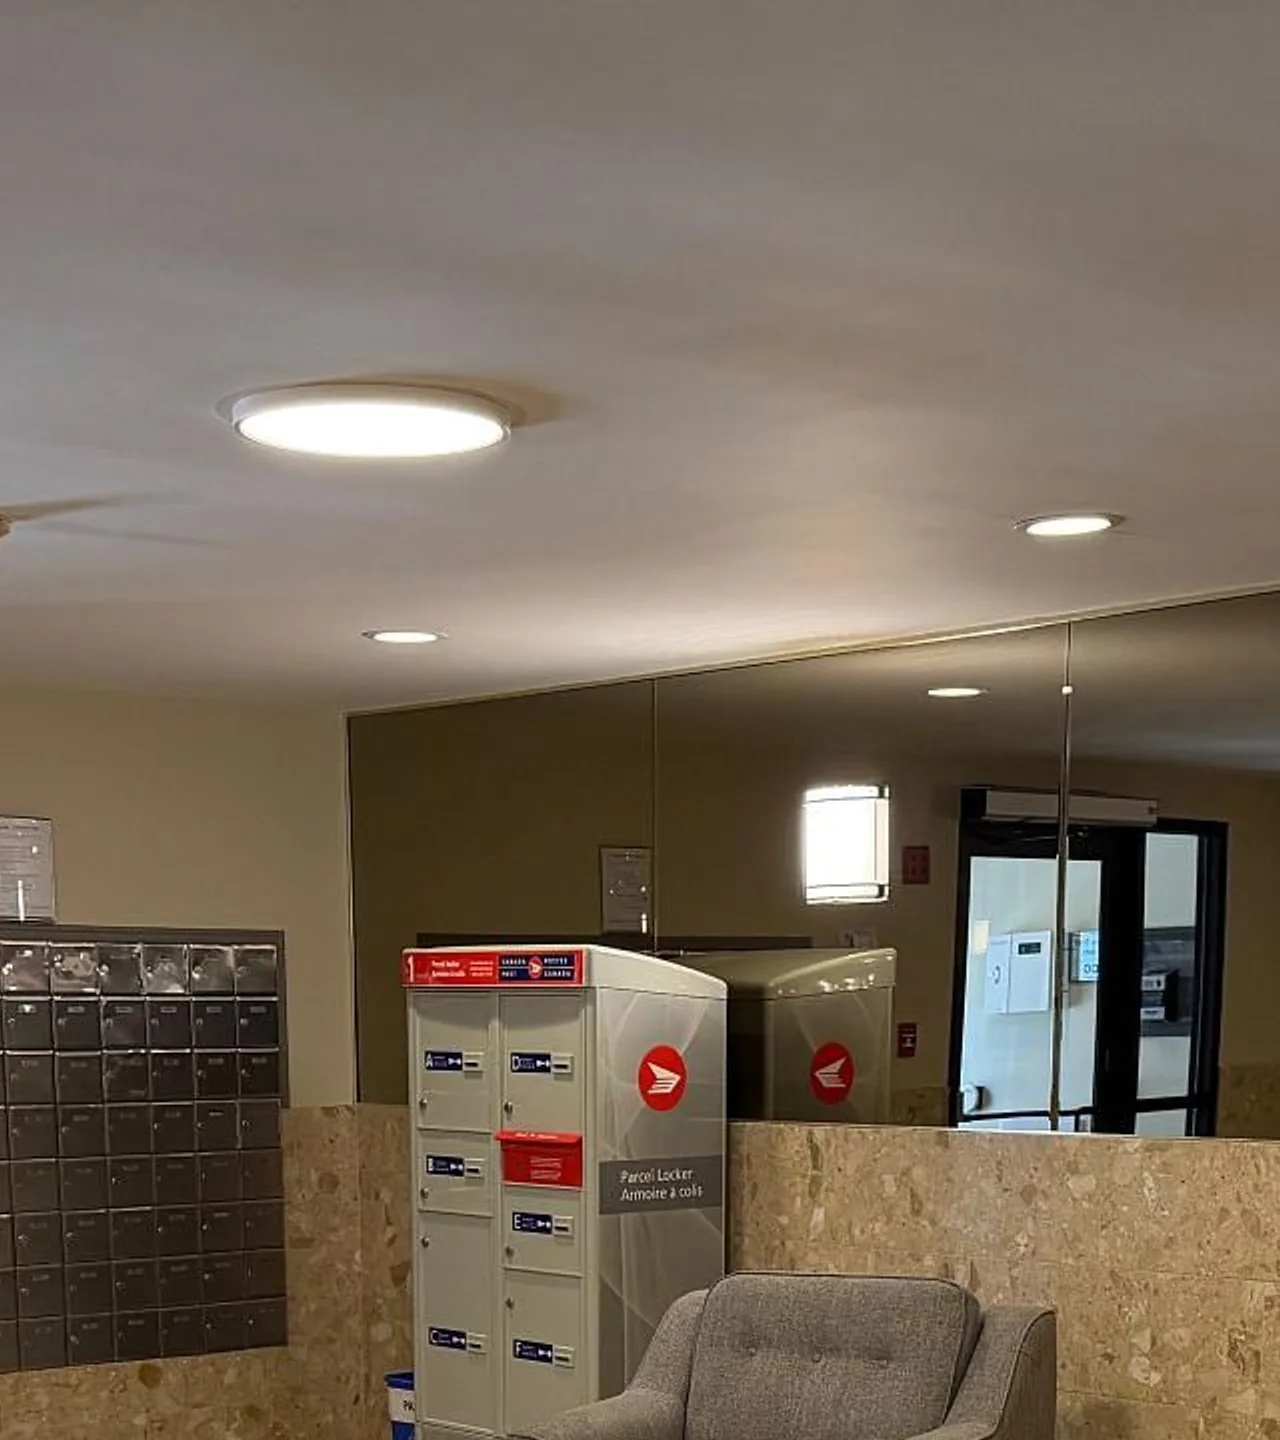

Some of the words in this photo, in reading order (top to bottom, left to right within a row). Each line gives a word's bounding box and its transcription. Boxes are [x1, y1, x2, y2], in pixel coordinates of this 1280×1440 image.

[426, 1053, 433, 1068] A
[512, 1055, 520, 1071] D
[620, 1168, 655, 1183] Parcel
[658, 1168, 694, 1181] Locker
[620, 1186, 668, 1201] Armoire
[679, 1183, 703, 1198] colis
[514, 1213, 521, 1230] E
